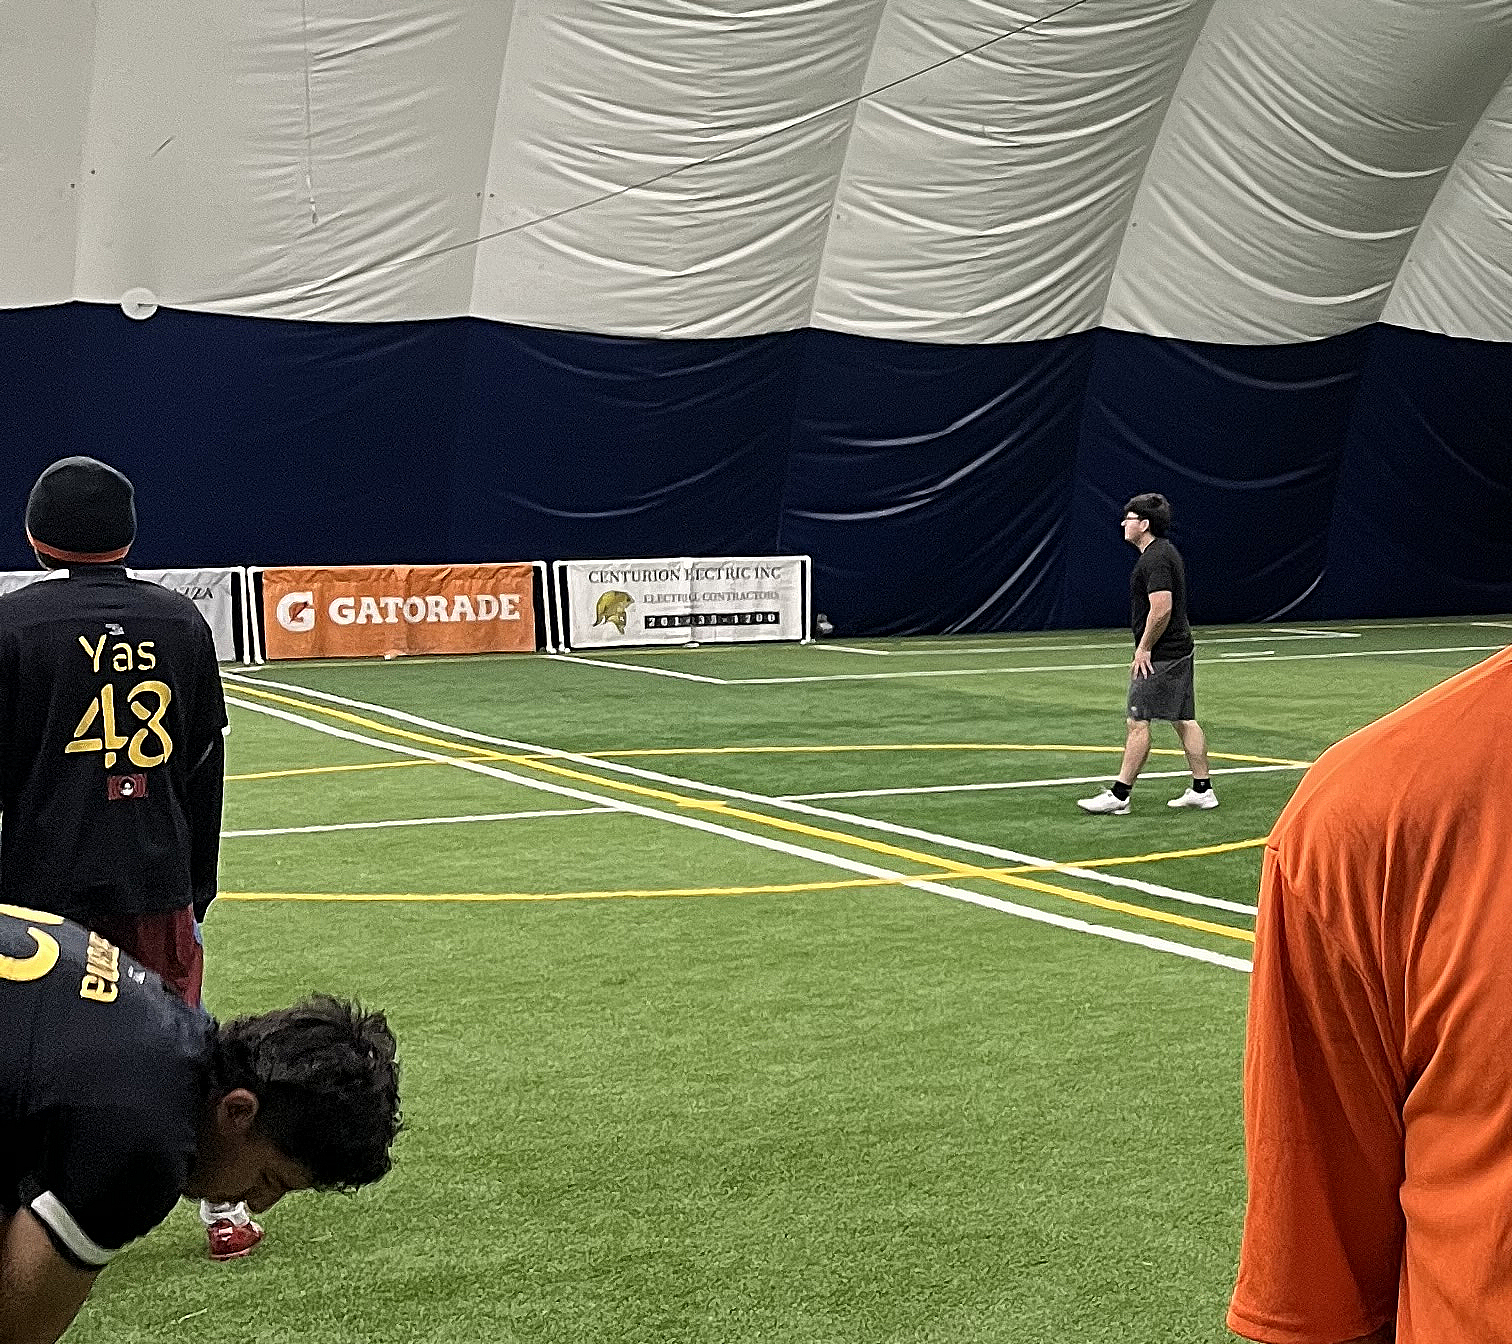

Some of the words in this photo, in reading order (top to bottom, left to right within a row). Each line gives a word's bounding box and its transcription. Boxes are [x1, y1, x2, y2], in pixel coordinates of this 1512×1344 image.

[588, 568, 681, 584] CENTURION
[753, 566, 781, 580] INC
[276, 591, 316, 632] G
[328, 593, 521, 625] GATORADE
[78, 633, 157, 673] Yas
[65, 680, 173, 769] 48
